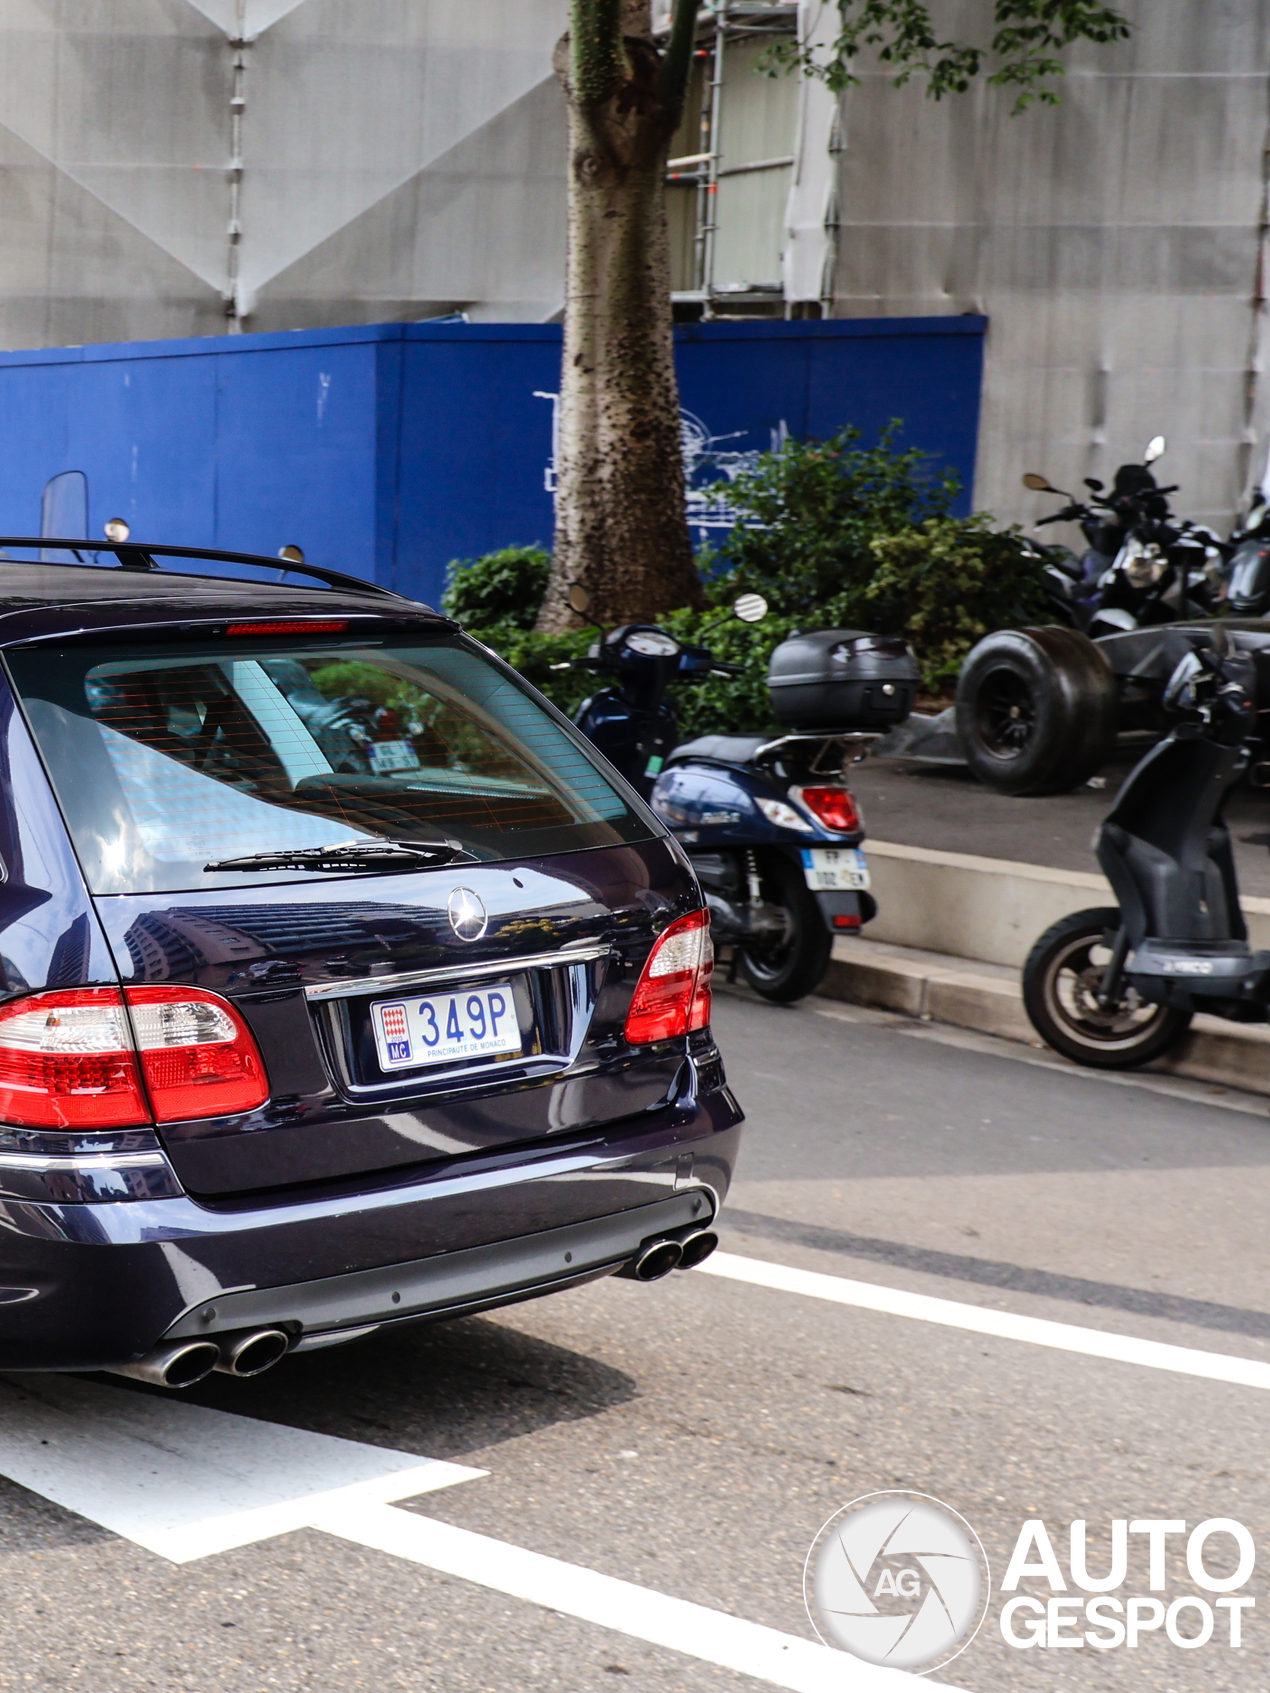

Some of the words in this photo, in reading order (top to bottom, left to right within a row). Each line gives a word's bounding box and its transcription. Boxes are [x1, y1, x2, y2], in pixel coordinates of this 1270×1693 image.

[418, 992, 506, 1047] 349P
[390, 1043, 407, 1059] MC
[427, 1045, 469, 1058] PRINCIPAUTE
[470, 1043, 478, 1051] DE
[480, 1039, 507, 1050] MONACO
